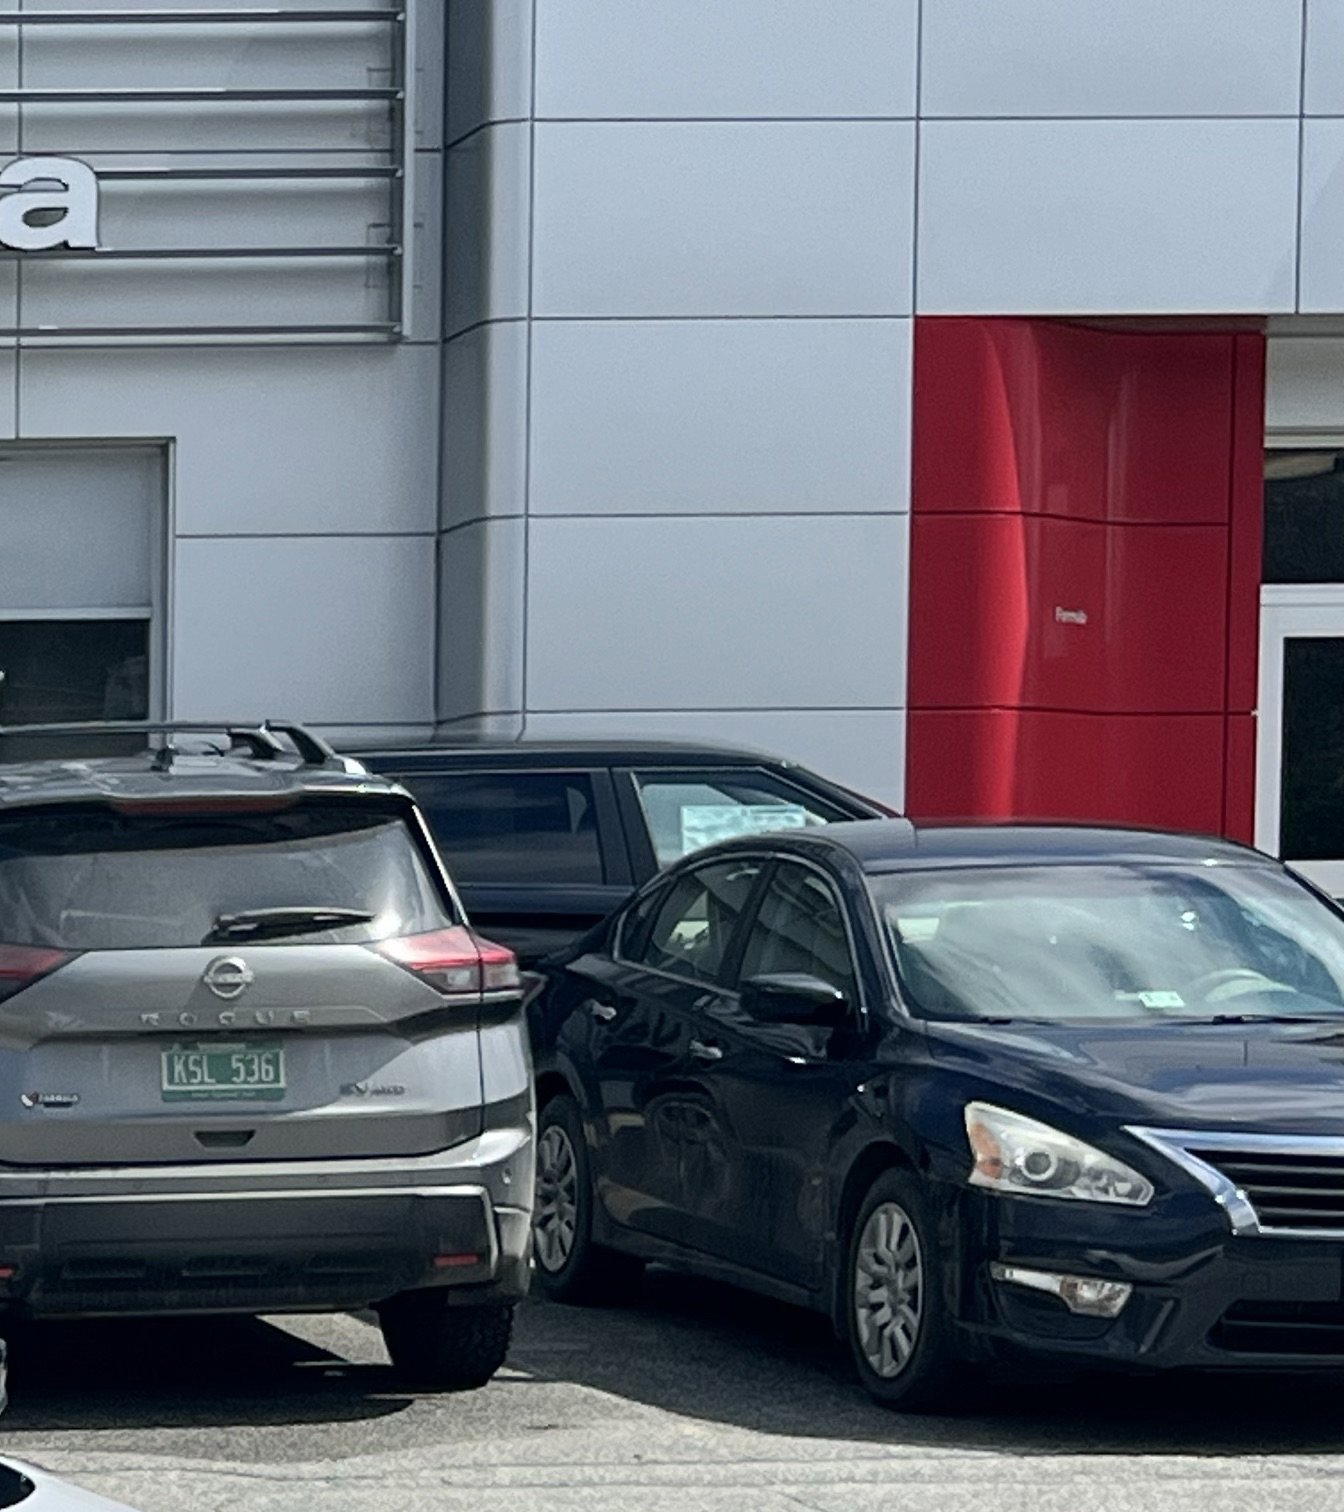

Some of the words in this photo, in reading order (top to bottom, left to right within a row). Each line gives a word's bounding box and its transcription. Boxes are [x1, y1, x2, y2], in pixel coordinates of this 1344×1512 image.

[141, 1010, 311, 1026] ROGUE
[173, 1055, 216, 1084] KSL
[231, 1053, 275, 1082] 536
